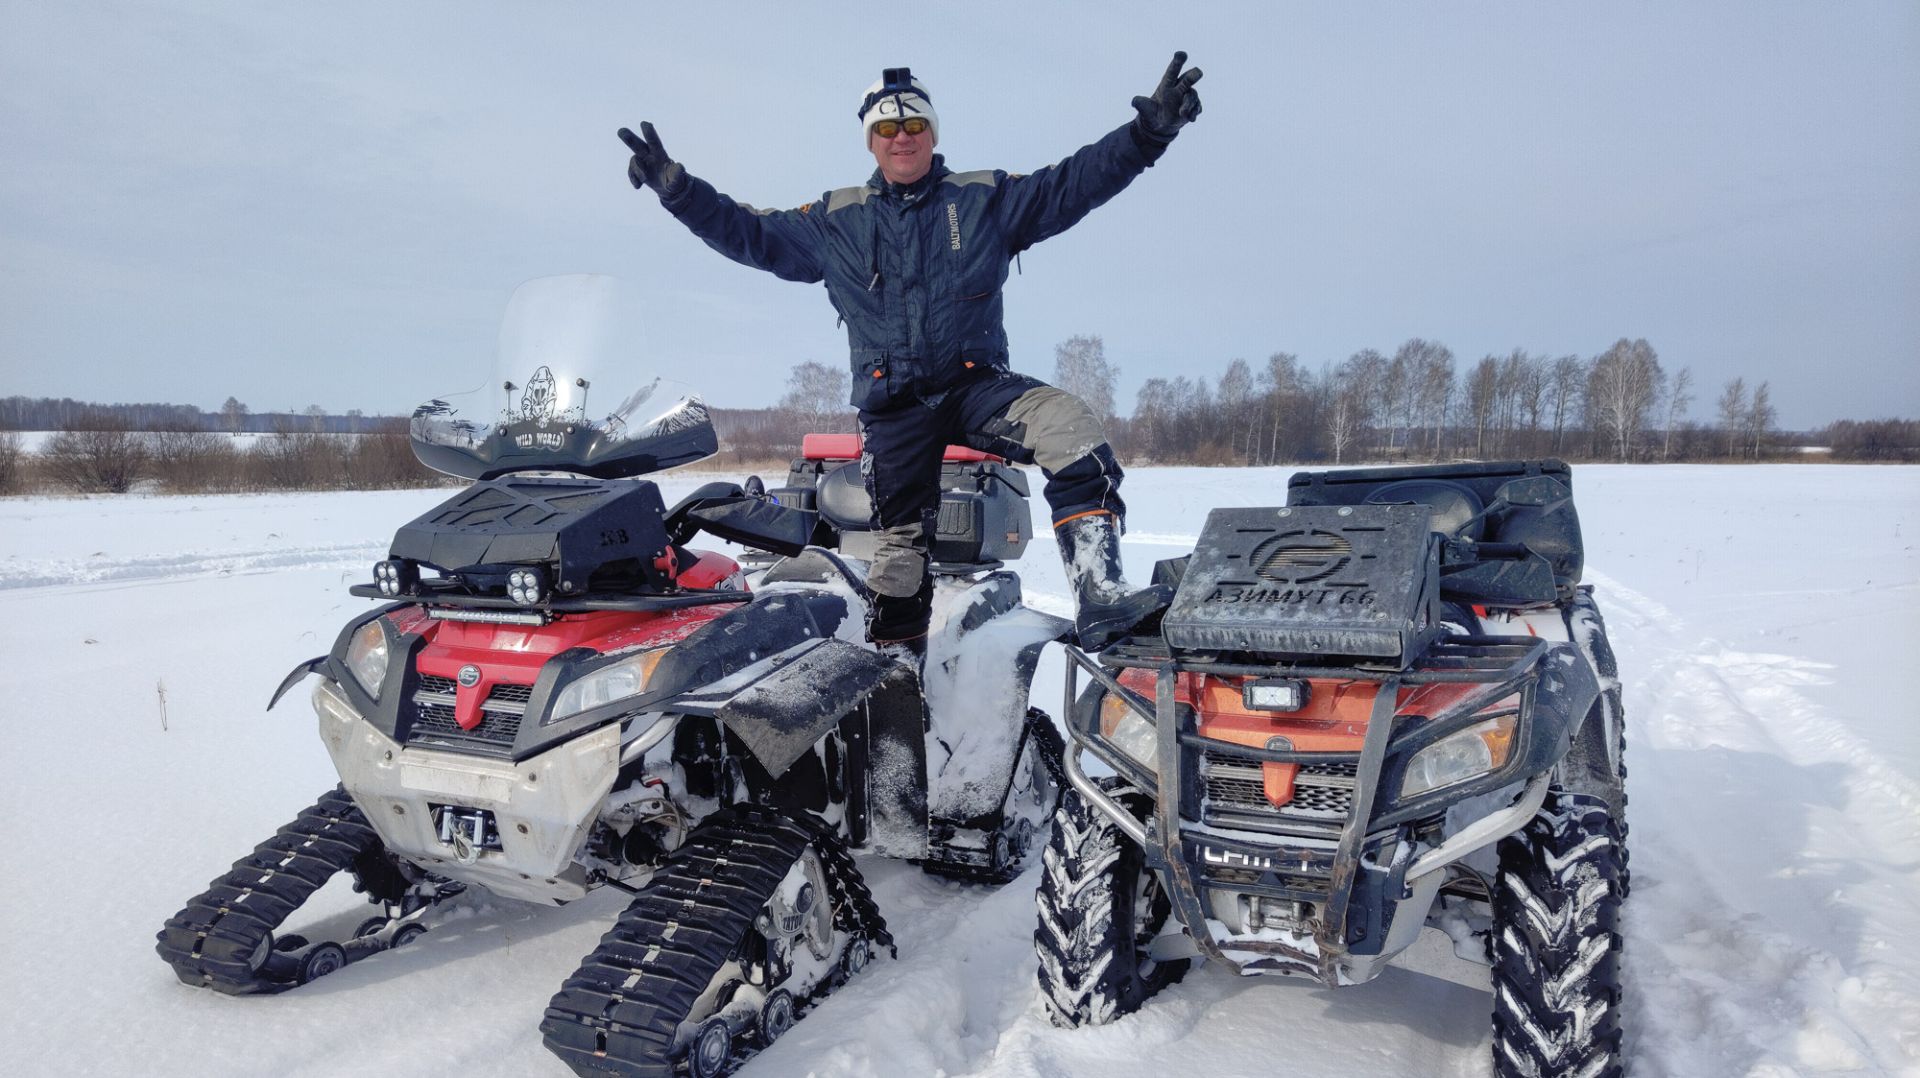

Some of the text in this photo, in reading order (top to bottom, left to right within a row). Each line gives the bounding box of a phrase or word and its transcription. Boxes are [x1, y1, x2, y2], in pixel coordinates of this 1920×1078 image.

[947, 203, 961, 250] BALTMOTORS
[515, 432, 562, 447] WILD WORLD
[1203, 588, 1377, 605] АЗИМУТ 66
